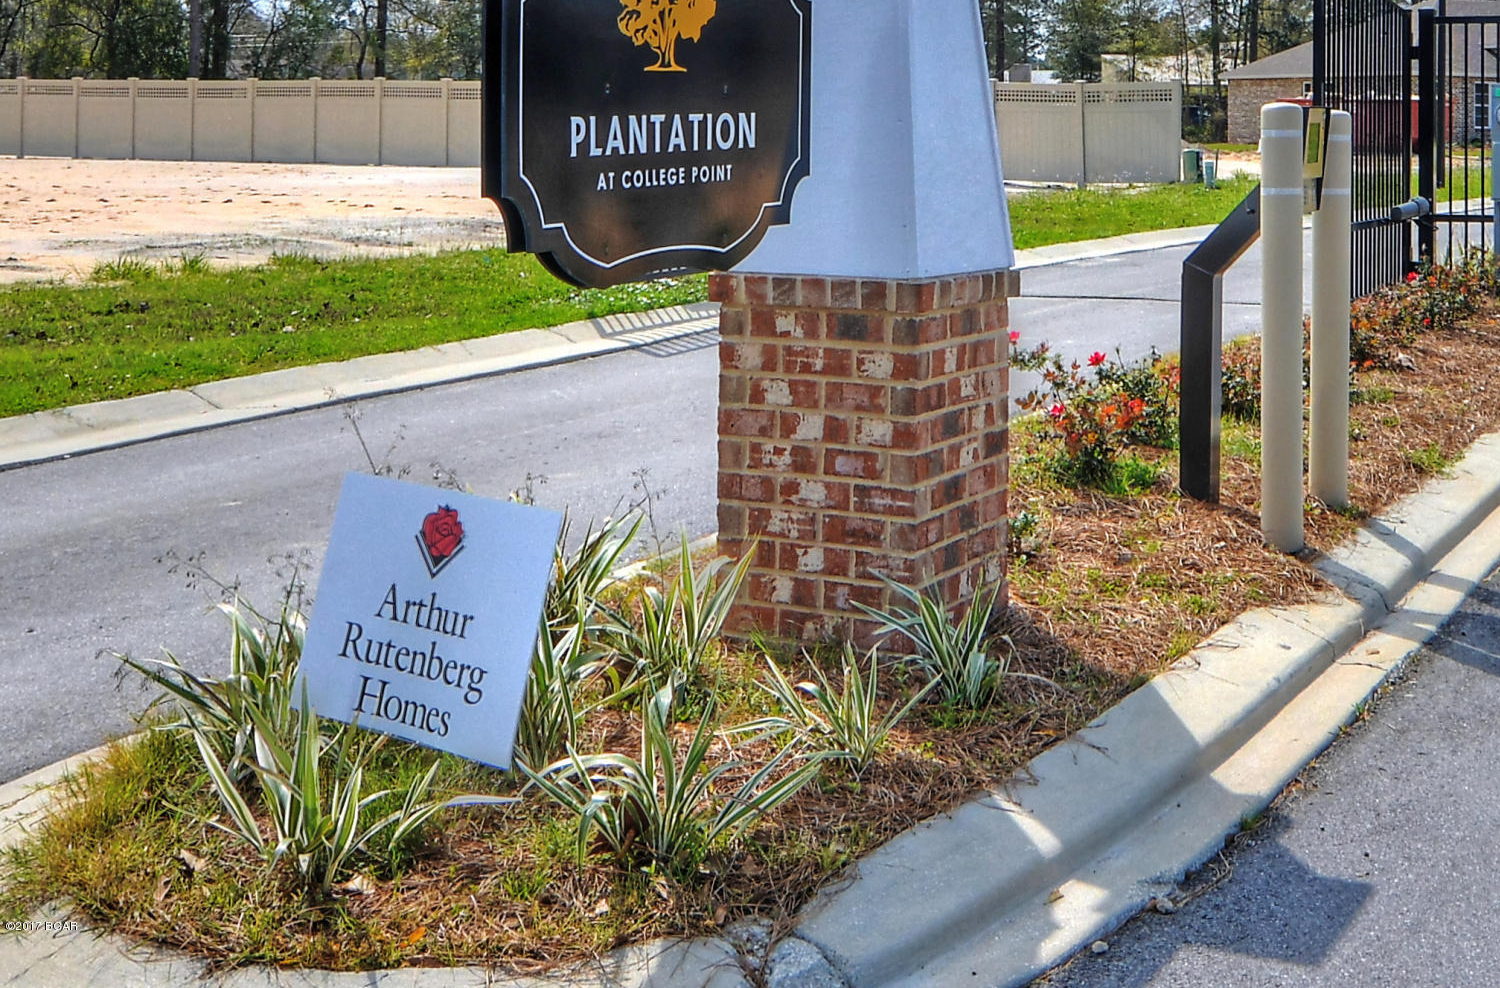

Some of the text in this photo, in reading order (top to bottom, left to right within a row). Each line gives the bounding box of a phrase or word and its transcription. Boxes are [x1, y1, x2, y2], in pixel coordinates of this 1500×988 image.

[569, 112, 757, 158] PLANTATION
[596, 164, 733, 191] AT COLLEGE POINT
[374, 582, 476, 640] Arthur
[338, 620, 488, 706] Rutenberg
[352, 674, 452, 738] Homes
